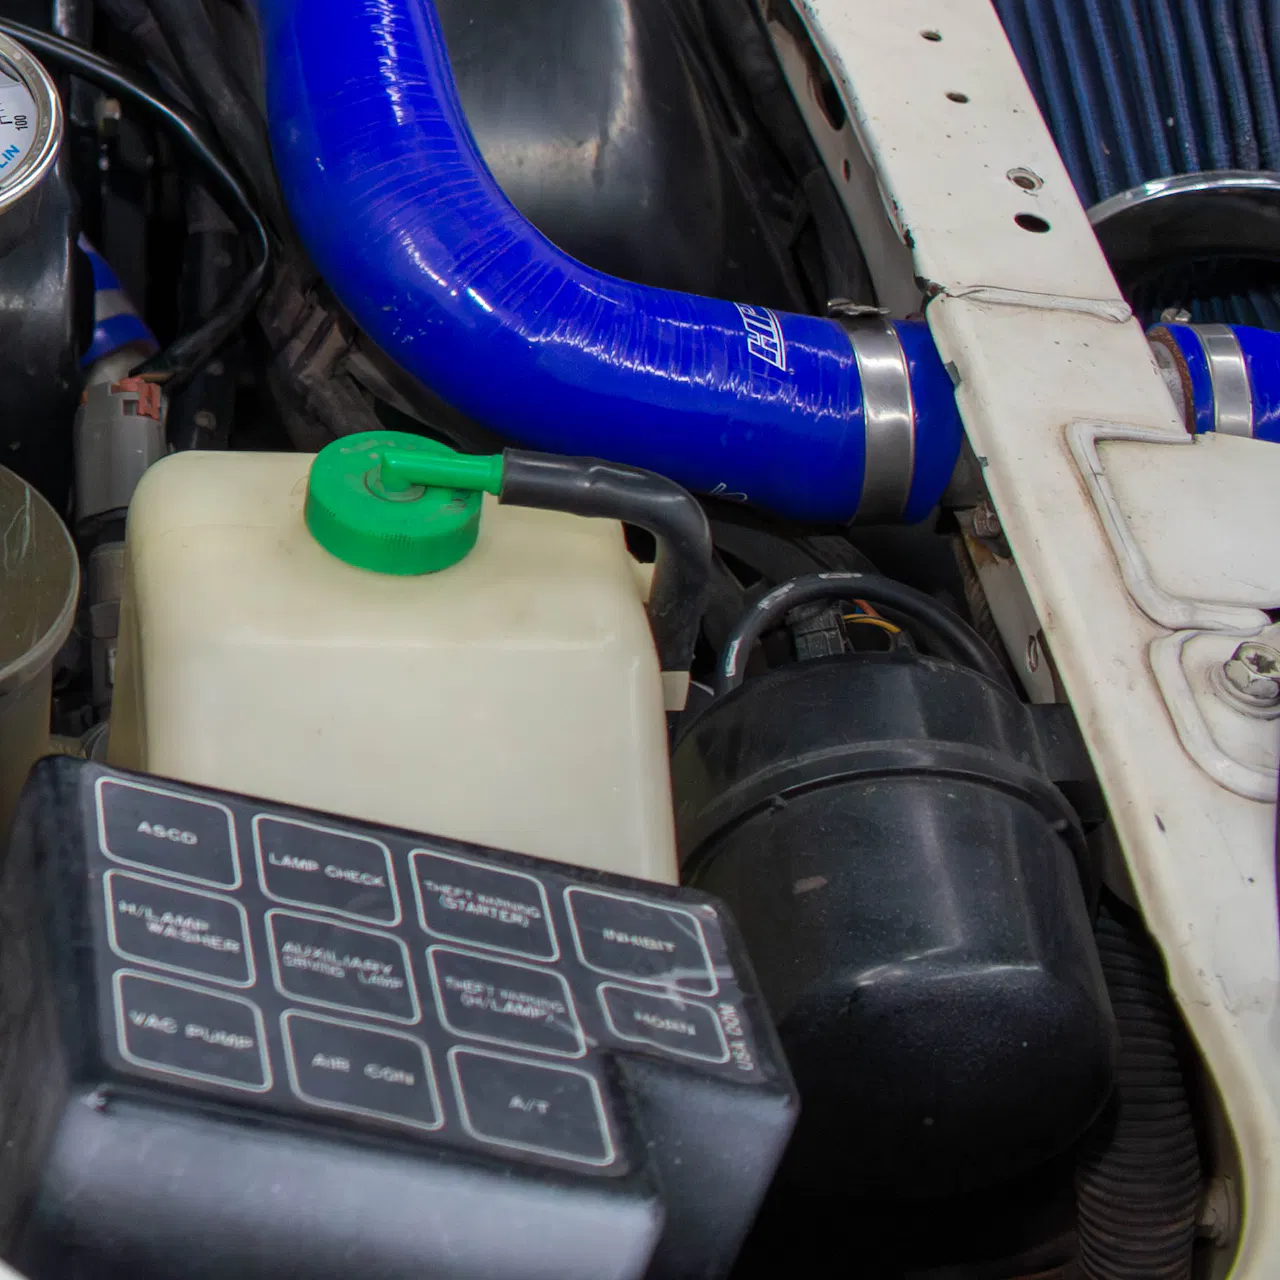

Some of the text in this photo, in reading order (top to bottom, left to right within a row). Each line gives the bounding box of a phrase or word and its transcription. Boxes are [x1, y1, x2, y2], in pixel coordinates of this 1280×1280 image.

[14, 115, 29, 131] 100
[268, 851, 385, 887] LAMP CHECK
[423, 878, 541, 918] THEFT WARNING
[439, 895, 530, 928] (STARTER)
[118, 900, 210, 931] H/LAMP
[145, 921, 241, 954] WASHER
[602, 927, 676, 953] INHIBIT
[282, 941, 393, 974] AUXILIARY
[357, 971, 403, 989] LAMP
[445, 975, 566, 1014] THEFT WARNING
[460, 991, 555, 1022] (H/LAMP)
[634, 1010, 696, 1036] HORN
[128, 1010, 254, 1050] VAC PUMP
[312, 1052, 415, 1086] AIR CON
[508, 1094, 551, 1115] A/T
